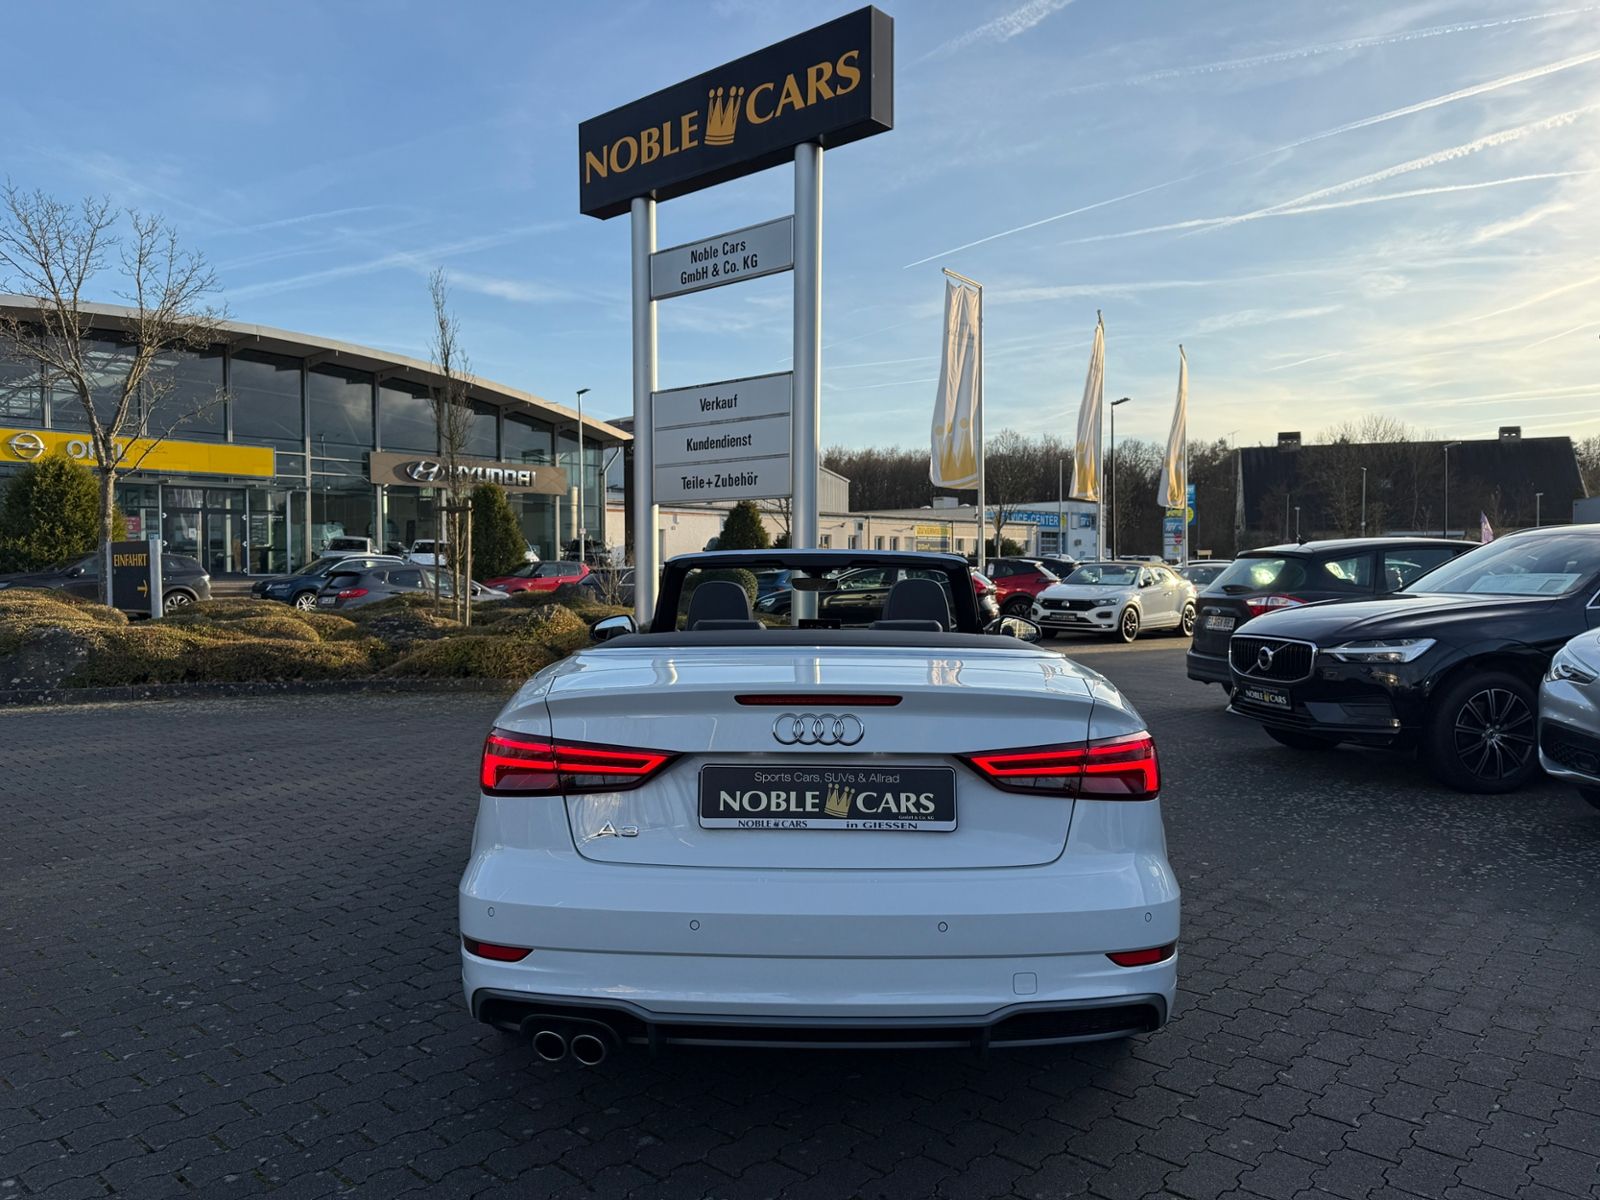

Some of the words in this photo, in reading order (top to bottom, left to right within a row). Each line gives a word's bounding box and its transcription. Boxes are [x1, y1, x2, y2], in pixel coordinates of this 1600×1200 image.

[585, 110, 699, 184] NOBLE
[746, 50, 861, 125] CARS
[690, 245, 718, 264] Noble
[722, 241, 746, 255] Cars
[680, 266, 708, 285] GmbH
[711, 263, 720, 277] &
[723, 260, 739, 274] Co.
[743, 254, 758, 270] KG
[700, 394, 738, 412] Verkauf
[686, 434, 752, 451] Kundendienst
[681, 472, 759, 490] Teile+Zubehör
[113, 553, 148, 567] EINFAHRT
[1245, 689, 1264, 700] NOBLE
[1269, 694, 1287, 704] CARS
[754, 772, 791, 784] Sports
[824, 773, 856, 783] SUVs
[858, 774, 866, 783] &
[867, 773, 900, 784] Allrad
[719, 791, 820, 812] NOBLE
[856, 792, 935, 813] CARS
[597, 820, 640, 837] A3
[738, 820, 772, 828] NOBLE
[780, 820, 808, 828] CARS
[846, 821, 858, 829] in
[862, 821, 918, 830] GIESSEN
